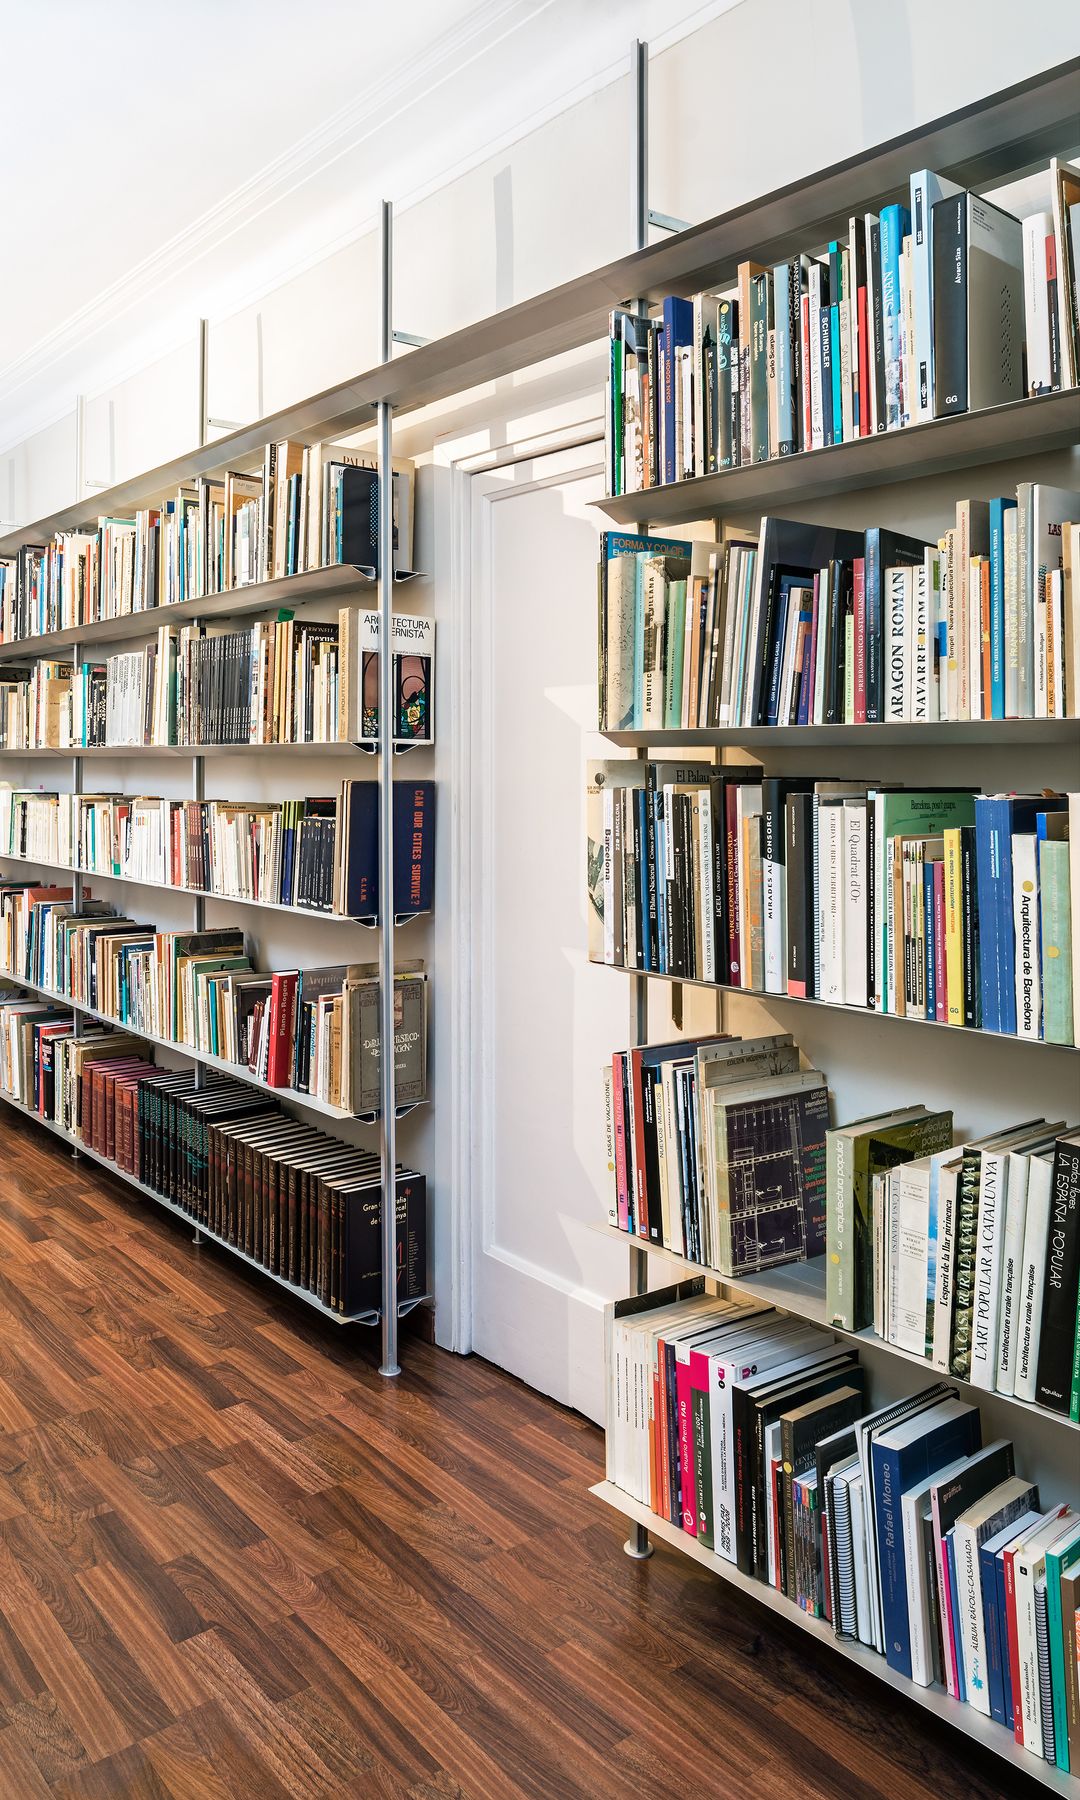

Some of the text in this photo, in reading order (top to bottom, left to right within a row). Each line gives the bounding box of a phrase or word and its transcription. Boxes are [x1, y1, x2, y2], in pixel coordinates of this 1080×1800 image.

[954, 247, 962, 261] Siza
[882, 270, 894, 310] SINAN
[768, 334, 776, 379] Carlo Scarpa
[821, 317, 830, 368] SCHINDLER
[945, 395, 958, 405] GG
[612, 537, 685, 556] FORMA Y COLOR
[947, 569, 955, 608] Arquitectura
[1018, 555, 1028, 590] zwanziger
[647, 576, 655, 623] SEVILLANA
[1018, 591, 1026, 603] der
[1018, 604, 1028, 644] Siedlungen
[856, 634, 864, 692] PRERROMÁNICO
[890, 572, 904, 718] ARAGON ROMAN
[947, 635, 955, 659] Tempel
[675, 769, 710, 783] El Palau
[410, 789, 424, 906] CAN OUR CITIES SURVIVE?
[848, 819, 861, 904] El Quadrat d'Or
[765, 863, 772, 874] AL
[765, 877, 773, 920] MIRADES
[1020, 894, 1033, 1031] Arquitectura de Barcelona
[280, 979, 288, 1008] Rogers
[605, 1124, 612, 1133] DE
[1058, 1152, 1071, 1167] LA
[834, 1138, 845, 1234] arquitectura popular
[362, 1203, 378, 1212] Gran
[941, 1199, 953, 1237] pirinenca
[940, 1253, 949, 1262] la
[940, 1262, 949, 1273] de
[957, 1165, 975, 1365] LA CASA RURAL A CATALUNYA
[974, 1160, 997, 1361] L'ART POPULAR A CATALUNYA
[1048, 1229, 1066, 1289] POPULAR
[938, 1273, 950, 1307] L'esperit
[1000, 1257, 1015, 1372] L'architecture rurale française
[1019, 1264, 1036, 1379] L'architecture rurale française
[680, 1418, 688, 1443] Premis
[882, 1462, 895, 1548] Rafael Moneo
